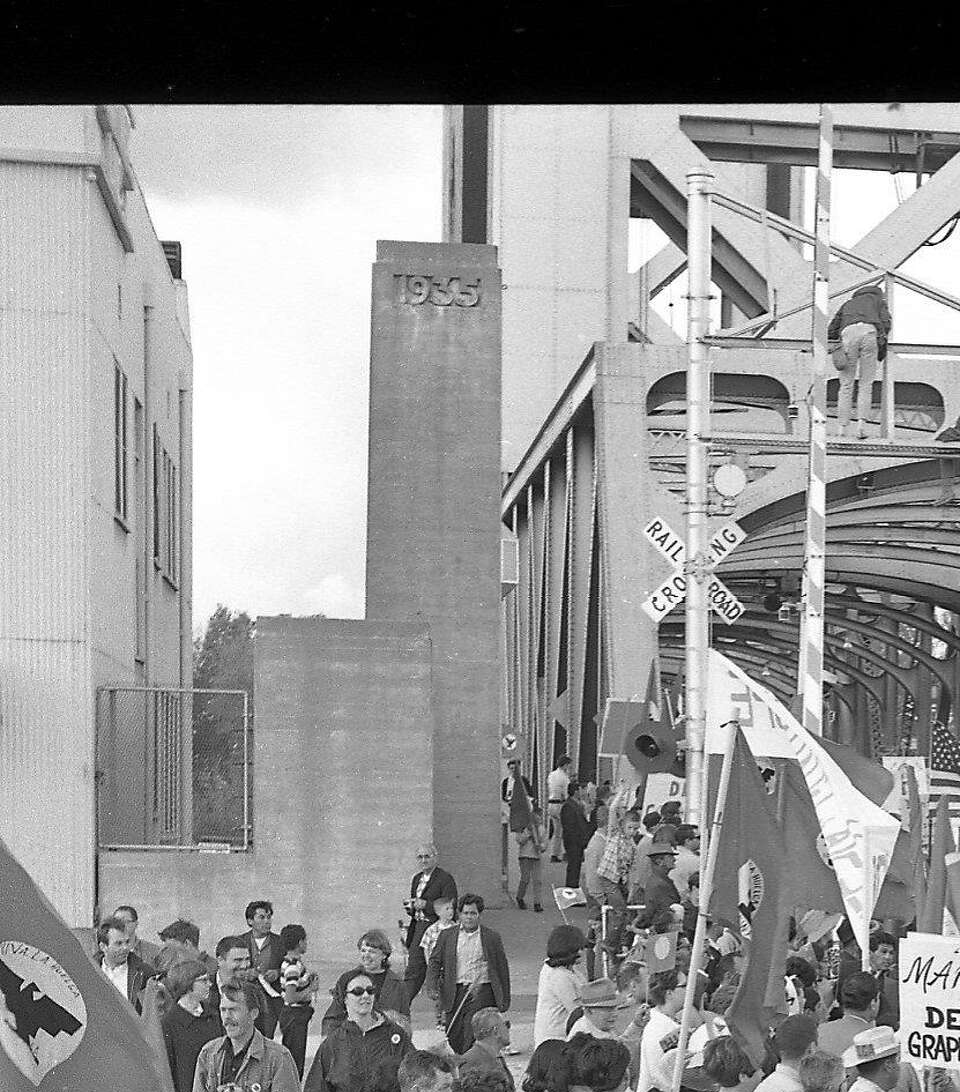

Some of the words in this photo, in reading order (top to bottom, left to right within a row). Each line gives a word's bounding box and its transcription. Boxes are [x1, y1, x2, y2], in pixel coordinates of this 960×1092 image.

[393, 274, 481, 307] 1935
[645, 520, 684, 562] RAIL
[707, 581, 742, 620] ROAD
